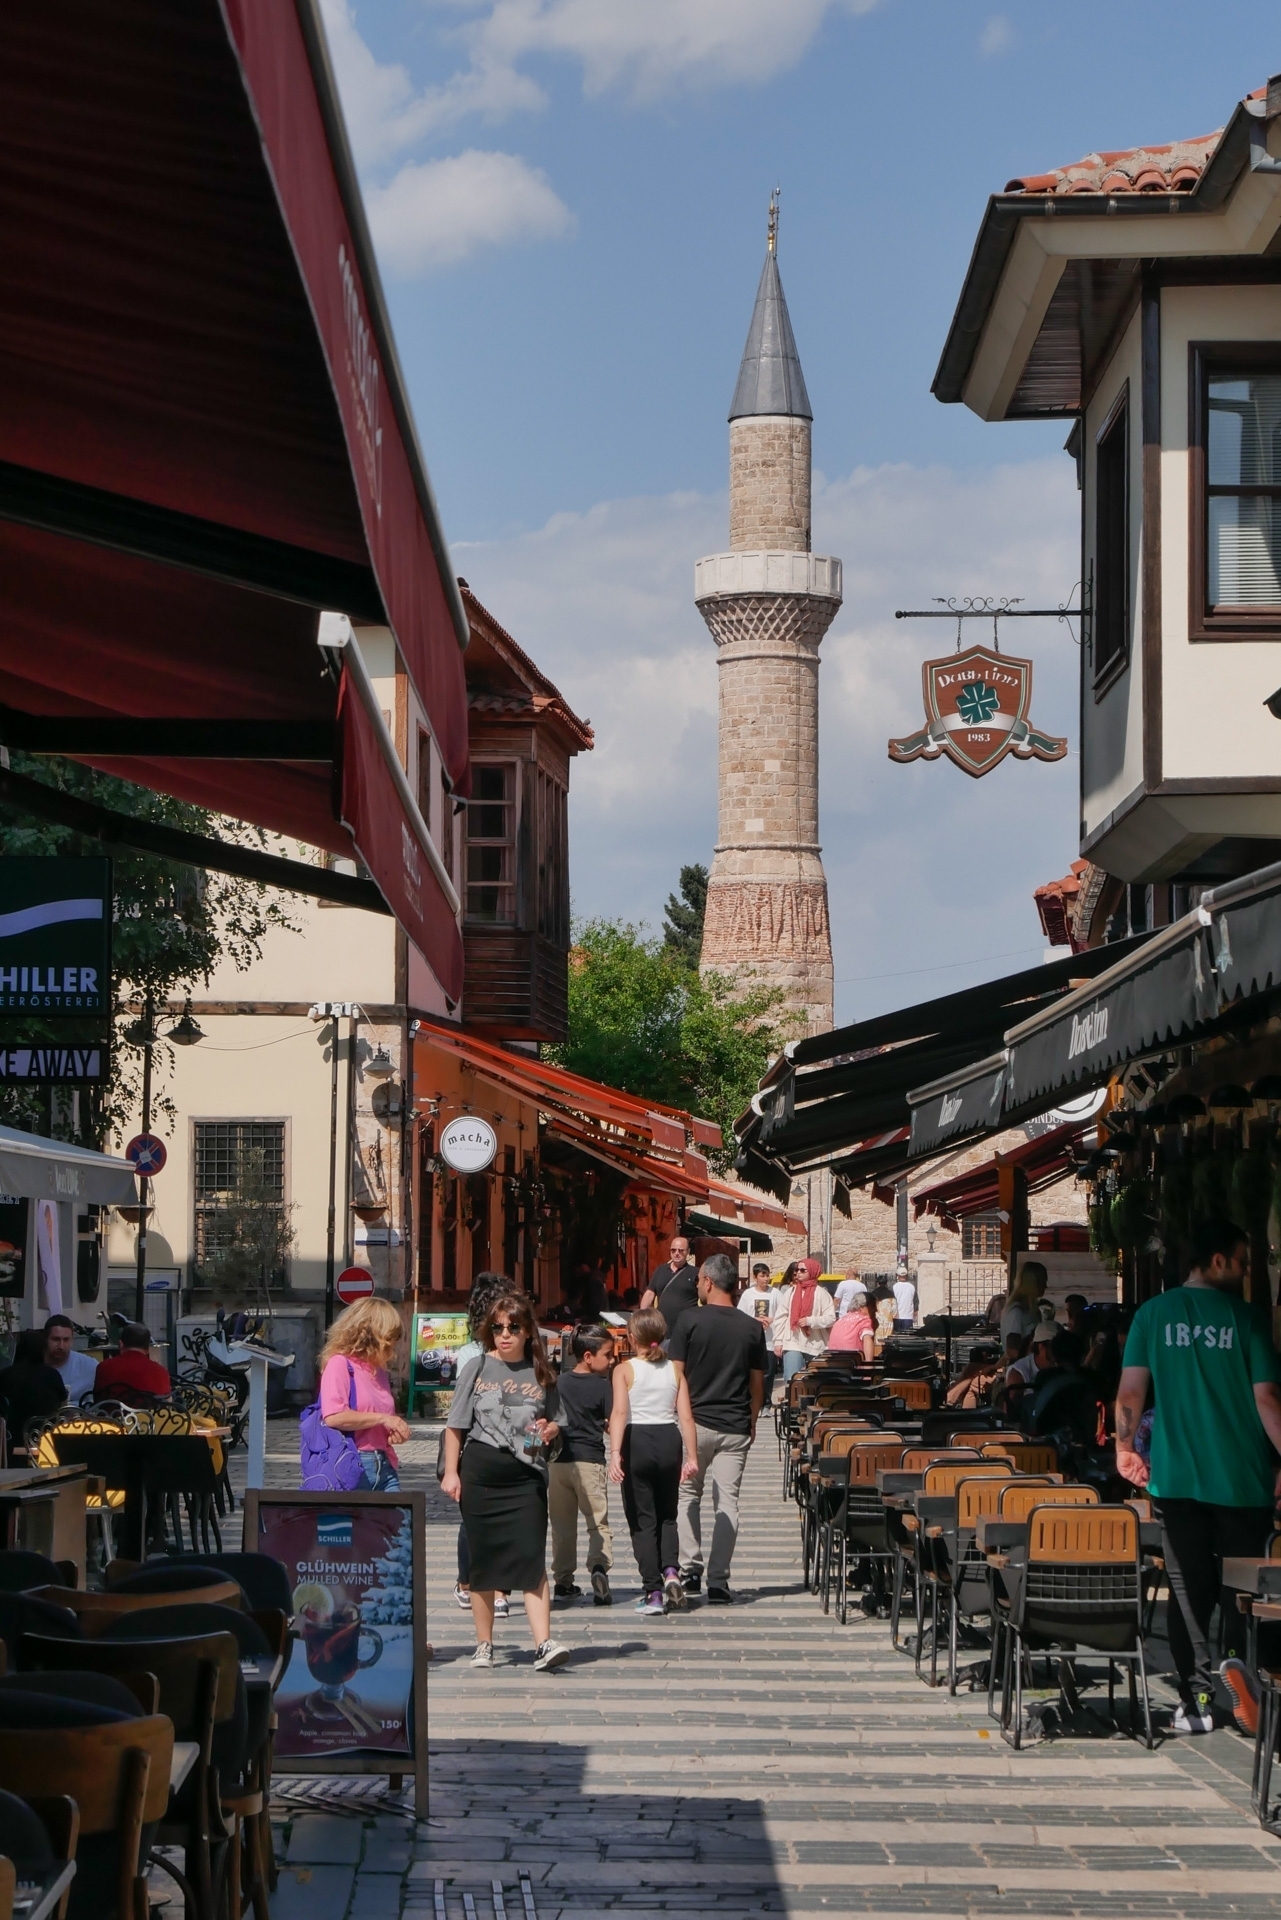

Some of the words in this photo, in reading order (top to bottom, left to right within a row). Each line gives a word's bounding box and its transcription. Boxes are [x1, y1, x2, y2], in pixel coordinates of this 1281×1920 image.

[967, 733, 991, 742] 1983
[0, 966, 99, 993] HILLER
[28, 1049, 92, 1077] AWAY
[447, 1133, 490, 1147] macha
[502, 1378, 518, 1394] It
[520, 1382, 543, 1401] Up
[318, 1535, 352, 1543] SCHILLER
[296, 1559, 374, 1574] GLÜHWEIN
[296, 1575, 340, 1585] MULLED
[343, 1575, 374, 1586] WINE
